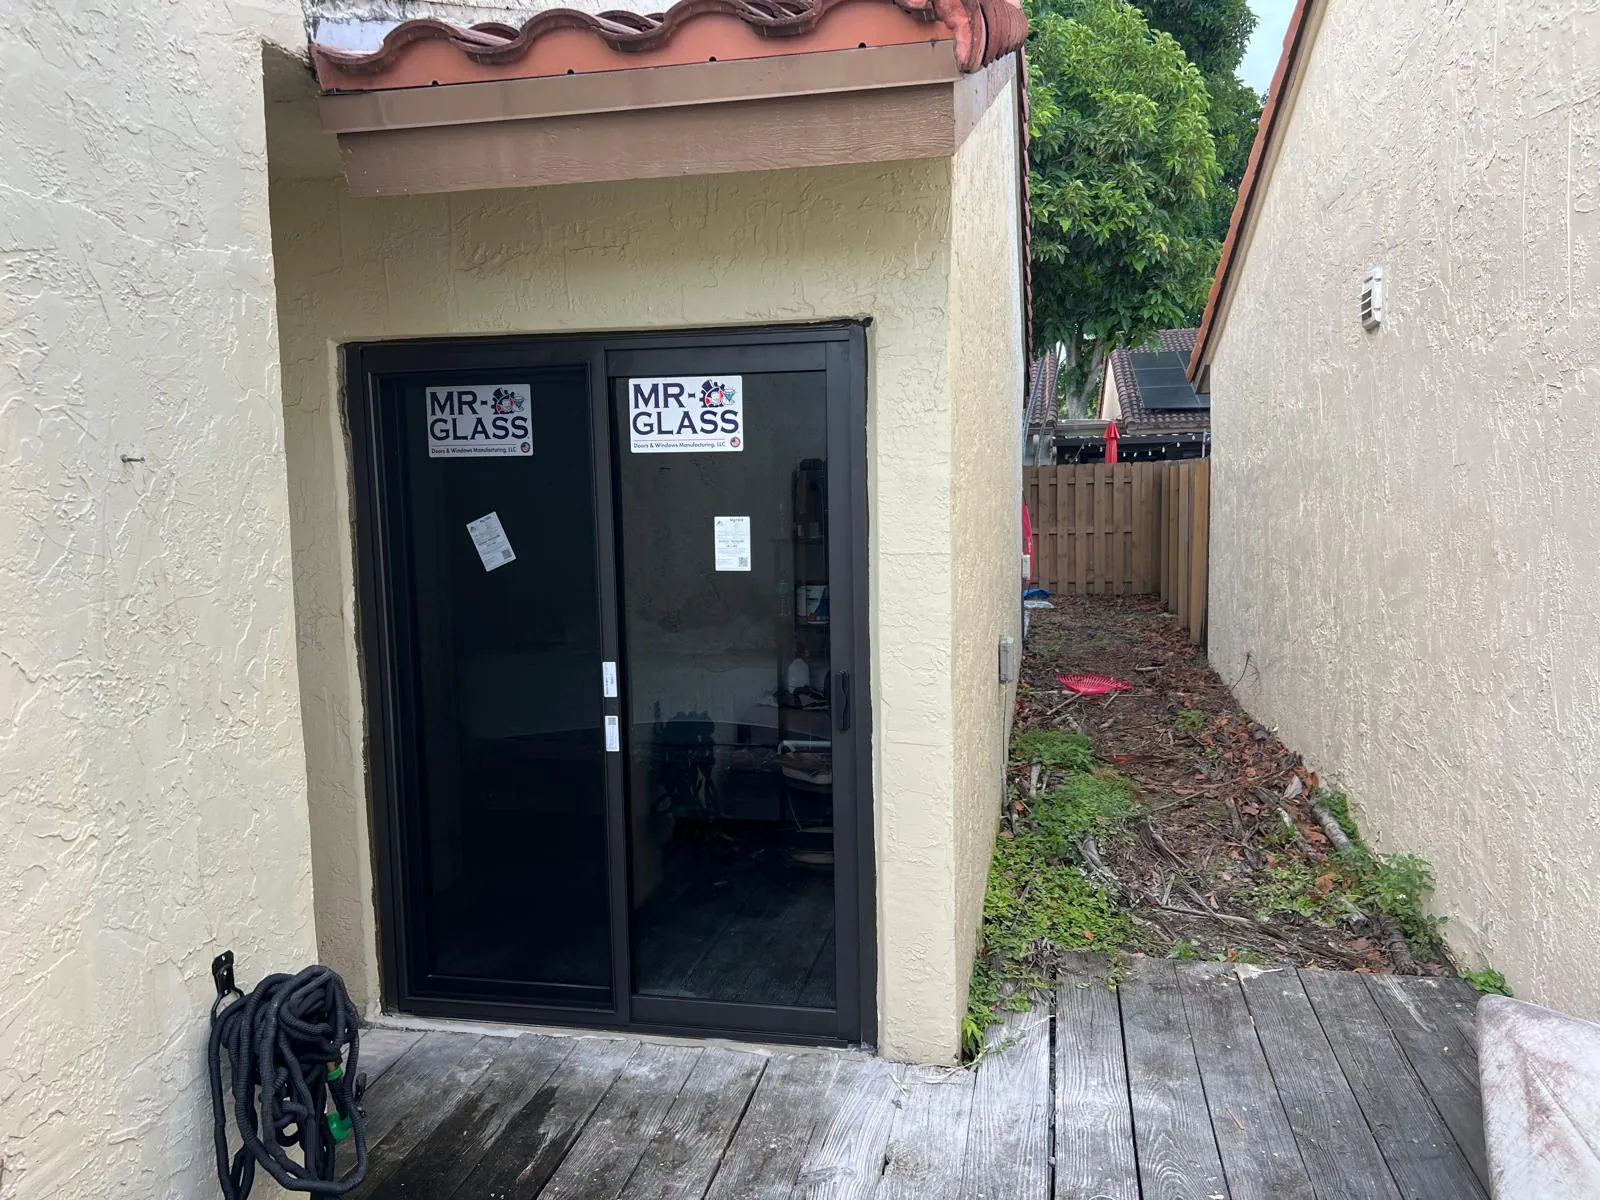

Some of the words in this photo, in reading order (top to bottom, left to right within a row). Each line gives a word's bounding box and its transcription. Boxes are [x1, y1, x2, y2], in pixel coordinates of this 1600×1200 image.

[632, 382, 696, 409] MR-
[429, 415, 529, 441] GLASS
[632, 409, 739, 436] GLASS
